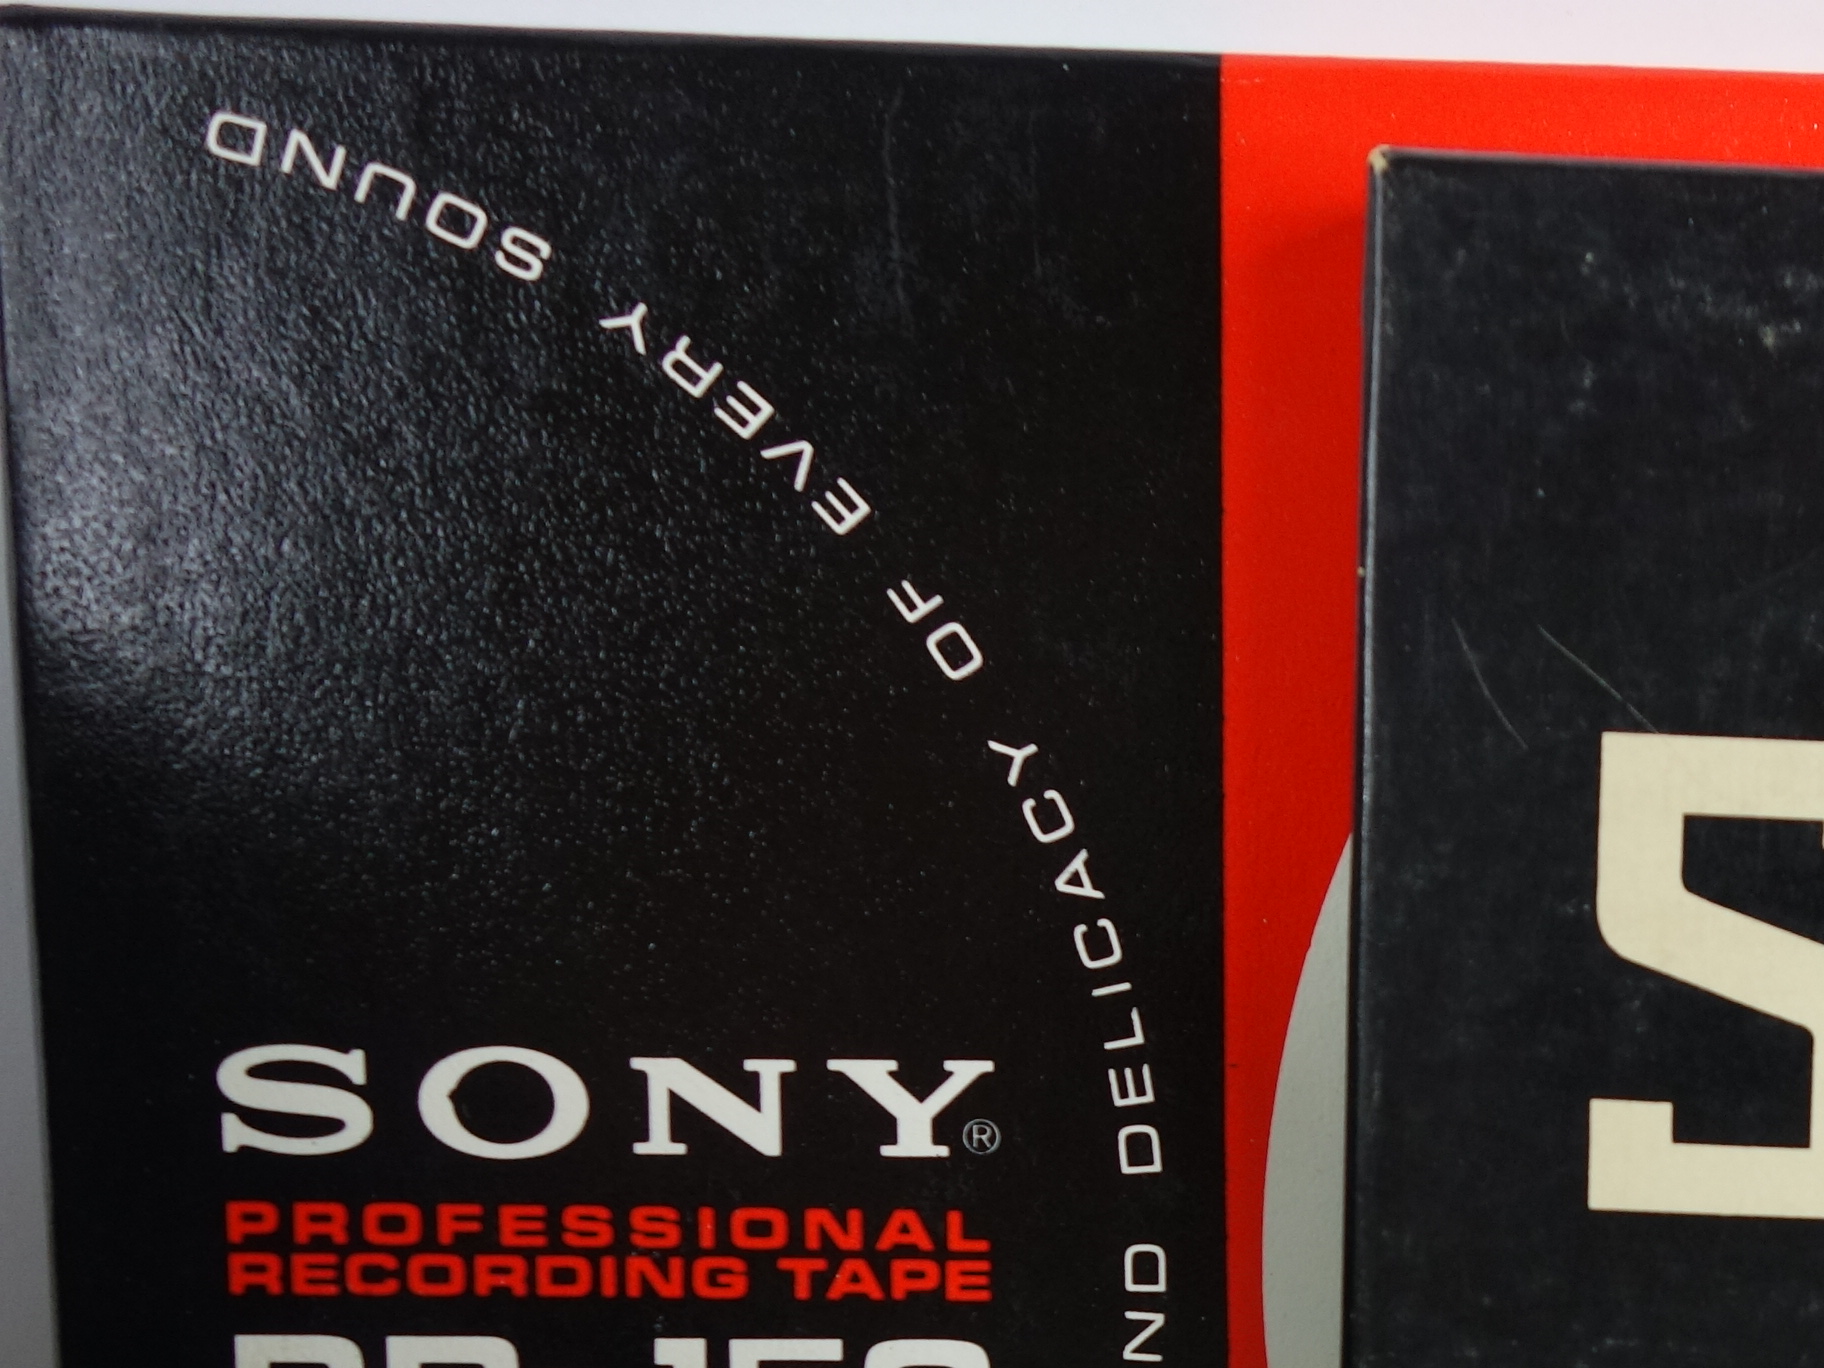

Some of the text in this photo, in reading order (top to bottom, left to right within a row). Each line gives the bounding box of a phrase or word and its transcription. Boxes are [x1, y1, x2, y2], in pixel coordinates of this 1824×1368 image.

[205, 111, 551, 281] SOUND
[599, 302, 871, 535] EVERY
[887, 580, 983, 680] OF
[987, 740, 1162, 1175] DELICACY
[216, 1044, 995, 1159] SONY
[226, 1201, 992, 1252] PROFESSIONAL
[228, 1252, 993, 1302] RECORDING TAPE
